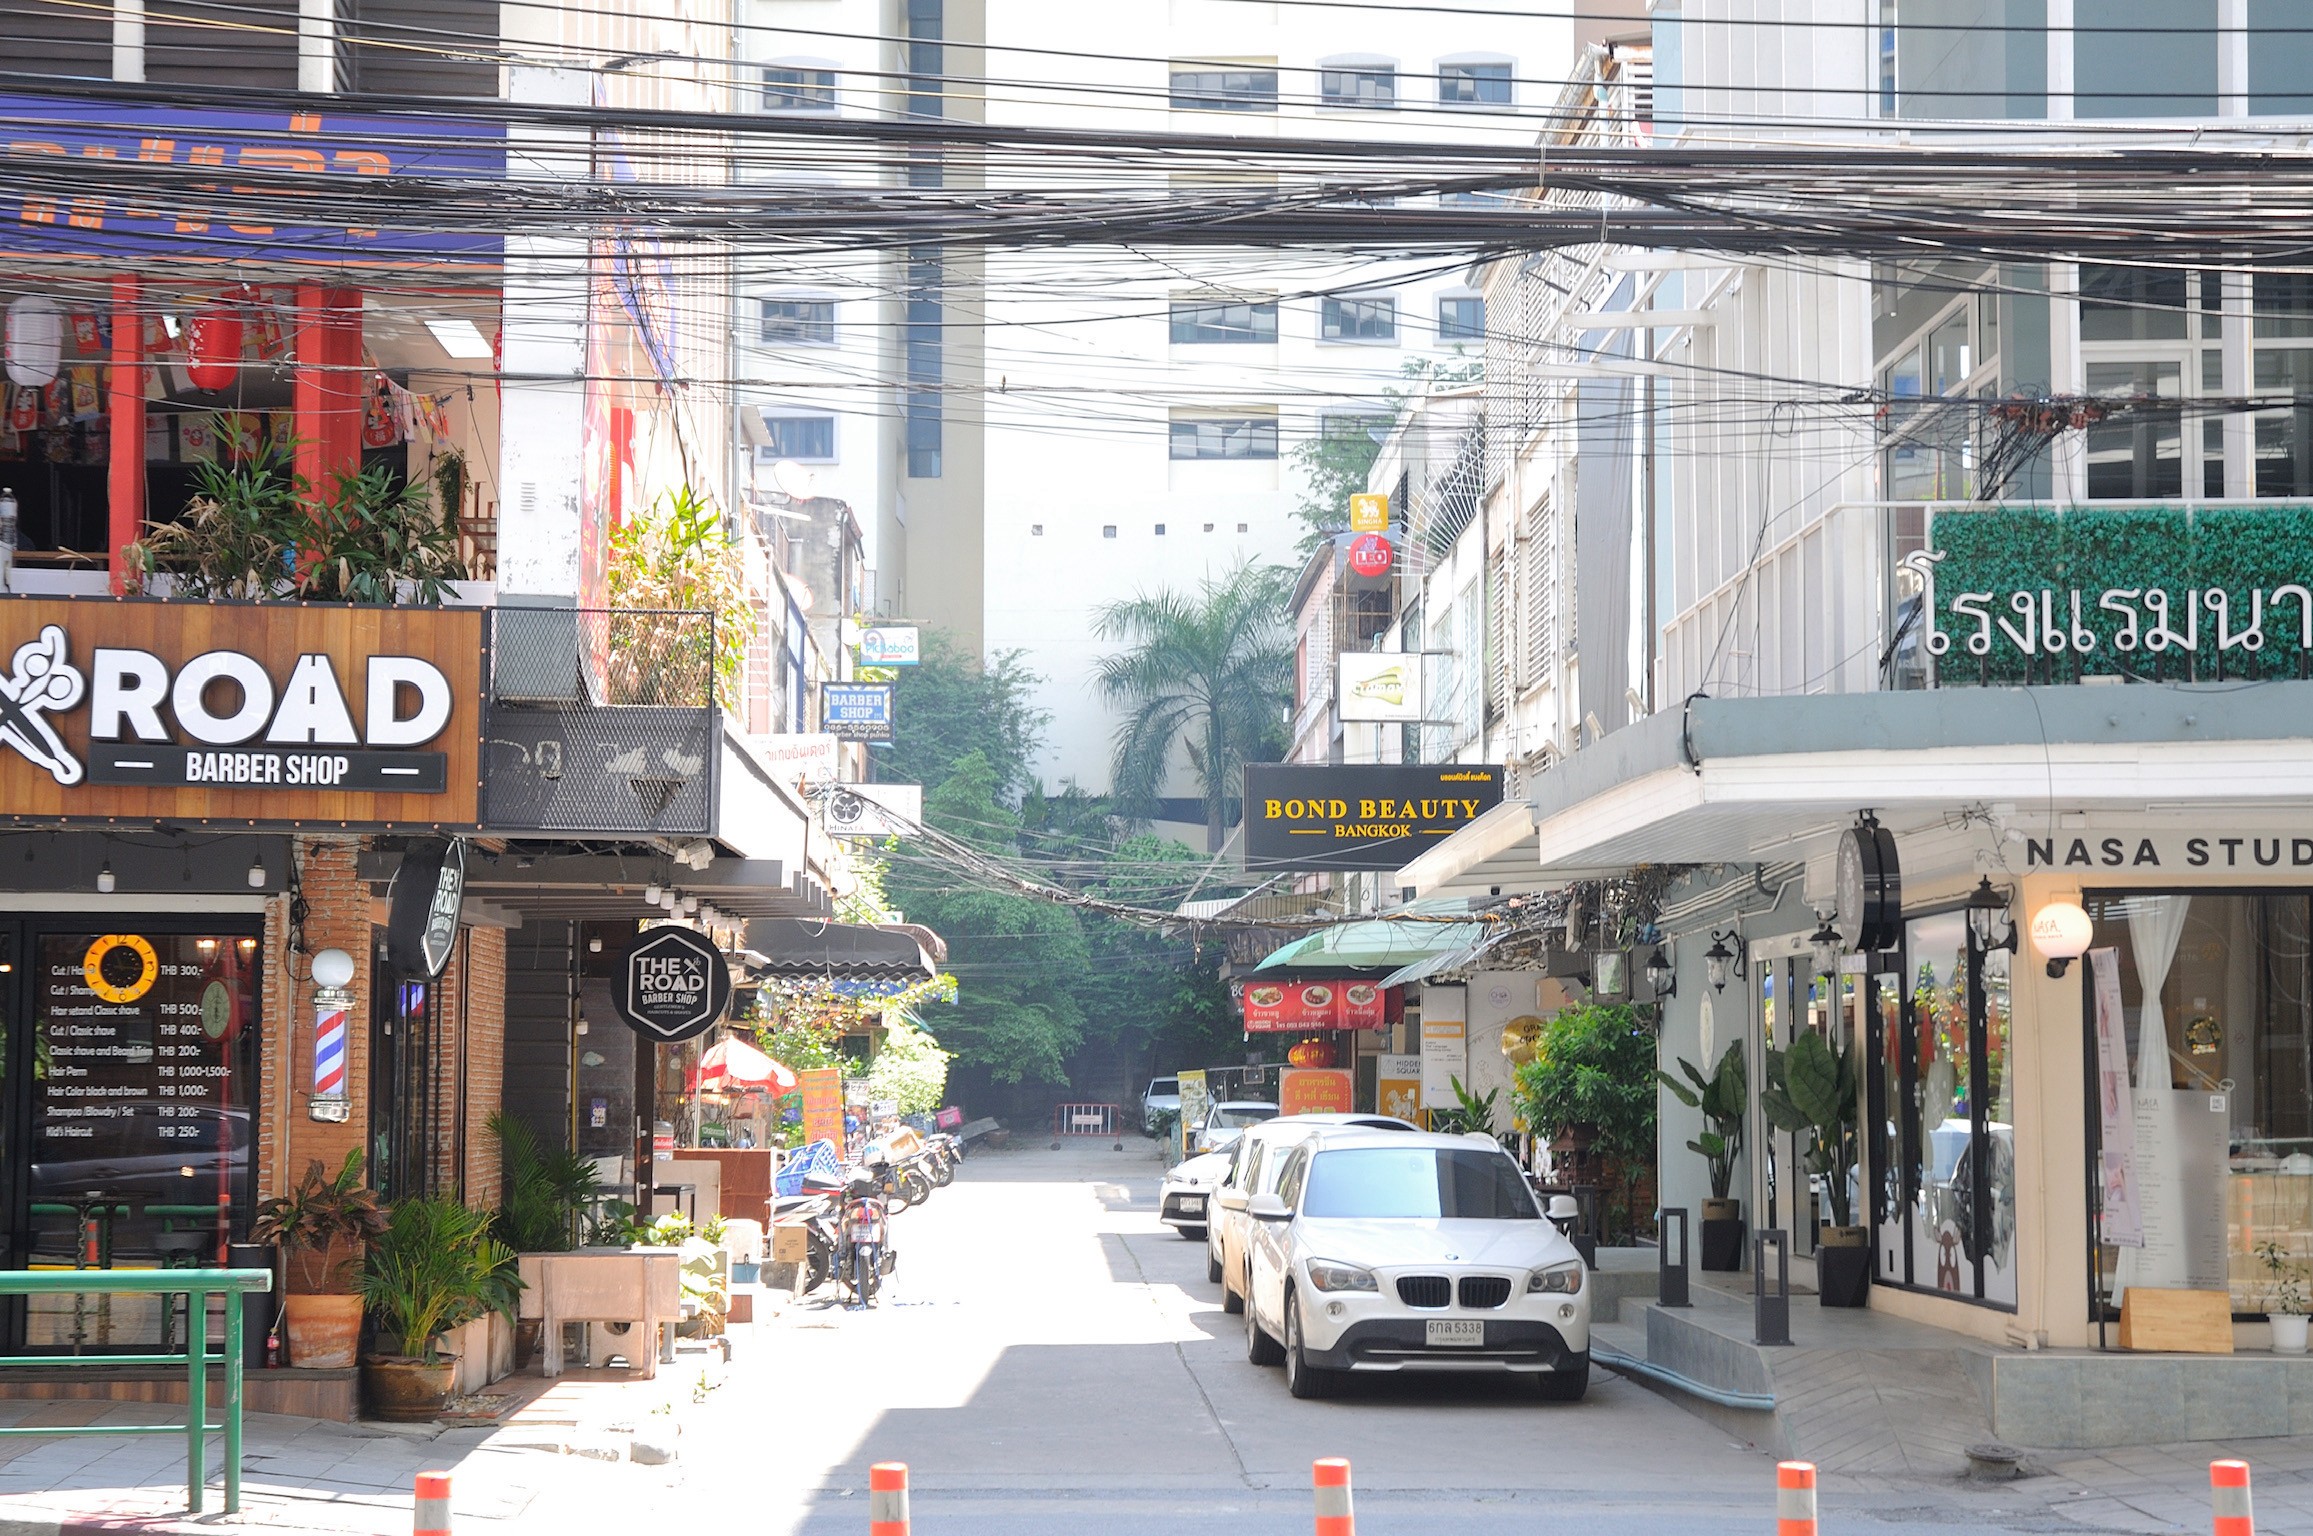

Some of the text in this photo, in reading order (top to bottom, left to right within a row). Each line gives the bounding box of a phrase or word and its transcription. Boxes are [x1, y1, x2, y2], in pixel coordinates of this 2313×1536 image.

[1358, 552, 1386, 563] LEO
[89, 648, 452, 745] ROAD
[831, 694, 882, 706] BARBER
[840, 707, 873, 718] SHOP
[185, 751, 349, 786] BARBER SHOP
[1264, 800, 1481, 819] BOND BEAUTY
[829, 824, 865, 832] HINATA
[1334, 824, 1412, 838] BANGKOK
[2026, 838, 2161, 867] NASA
[438, 866, 457, 891] THE
[433, 889, 458, 914] ROAD
[51, 965, 66, 976] Cut
[161, 965, 177, 976] THB
[636, 957, 680, 974] THE
[640, 974, 705, 991] ROAD
[50, 985, 65, 996] Cut
[641, 992, 698, 1006] BARBER SHOP
[50, 1006, 67, 1016] Hair
[94, 1005, 118, 1016] Classic
[118, 1005, 140, 1016] shave
[160, 1004, 177, 1015] THB
[50, 1025, 65, 1036] Cut
[70, 1025, 94, 1036] Classic
[94, 1025, 116, 1036] shave
[160, 1024, 176, 1036] THB
[49, 1045, 73, 1056] Classic
[74, 1045, 95, 1056] shave
[96, 1045, 111, 1056] and
[112, 1045, 136, 1056] Beard
[136, 1045, 153, 1056] Trim
[158, 1046, 174, 1057] THB
[48, 1066, 65, 1076] Hair
[66, 1066, 88, 1076] Perm
[158, 1066, 174, 1077] THB
[47, 1086, 65, 1096] Hair
[65, 1086, 86, 1096] Color
[86, 1086, 107, 1096] black
[108, 1086, 123, 1096] and
[124, 1086, 148, 1096] brown
[158, 1086, 174, 1097] THB
[47, 1106, 82, 1117] Shampoo
[122, 1106, 134, 1117] Set
[158, 1107, 174, 1117] THB
[64, 1126, 93, 1137] Haircut
[158, 1126, 174, 1137] THB
[1429, 1322, 1482, 1333] 6กล 5338
